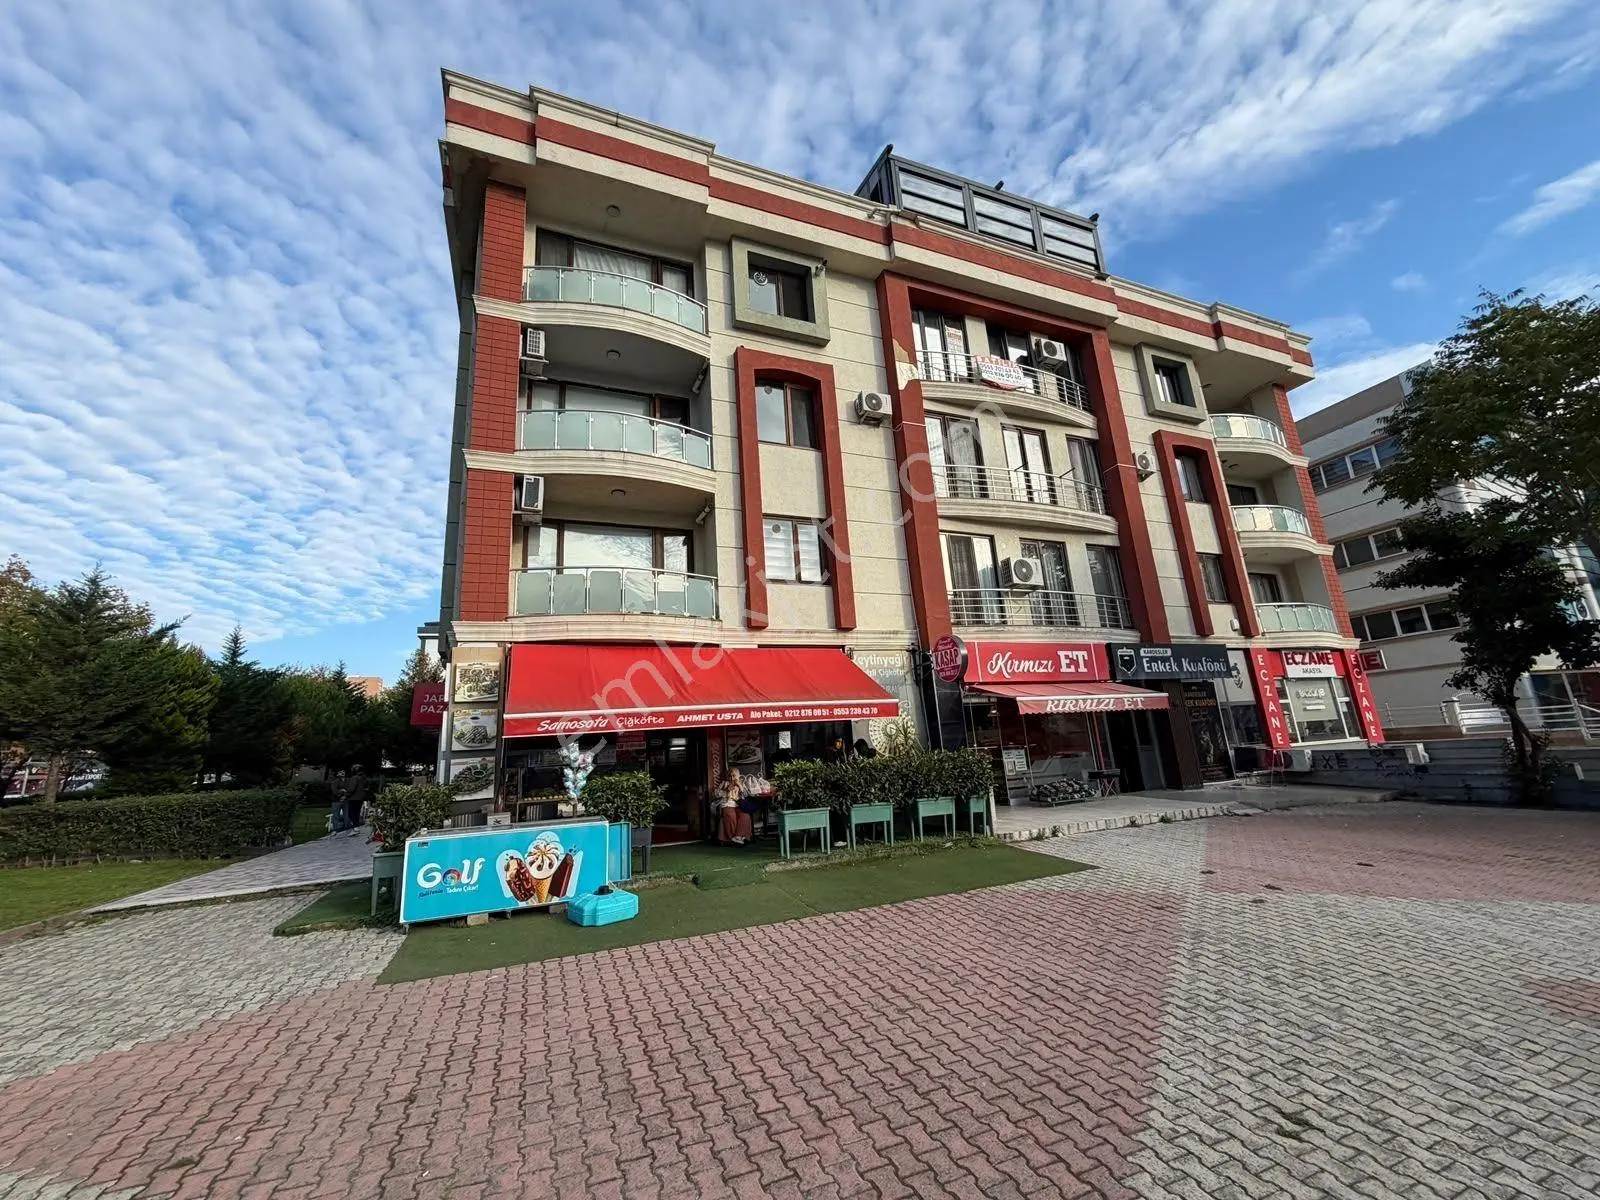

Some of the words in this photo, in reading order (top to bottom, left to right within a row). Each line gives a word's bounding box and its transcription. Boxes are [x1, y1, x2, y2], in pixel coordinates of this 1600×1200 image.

[934, 649, 959, 669] KASAP
[988, 651, 1055, 679] Kırmızı
[1057, 651, 1089, 673] ET
[1284, 651, 1334, 665] ECZANE
[423, 694, 445, 703] JAP
[1046, 698, 1117, 712] KIRMIZI
[1122, 696, 1145, 709] ET
[1257, 654, 1284, 745] ECZANE
[1350, 654, 1378, 738] ECZANE
[420, 704, 445, 714] PAZ
[616, 714, 665, 727] Çiğköfte
[676, 713, 714, 723] AHMET
[717, 712, 744, 721] USTA
[750, 710, 760, 719] Alo
[761, 709, 783, 719] Paket:
[785, 708, 800, 718] 0212
[417, 857, 486, 889] Golf
